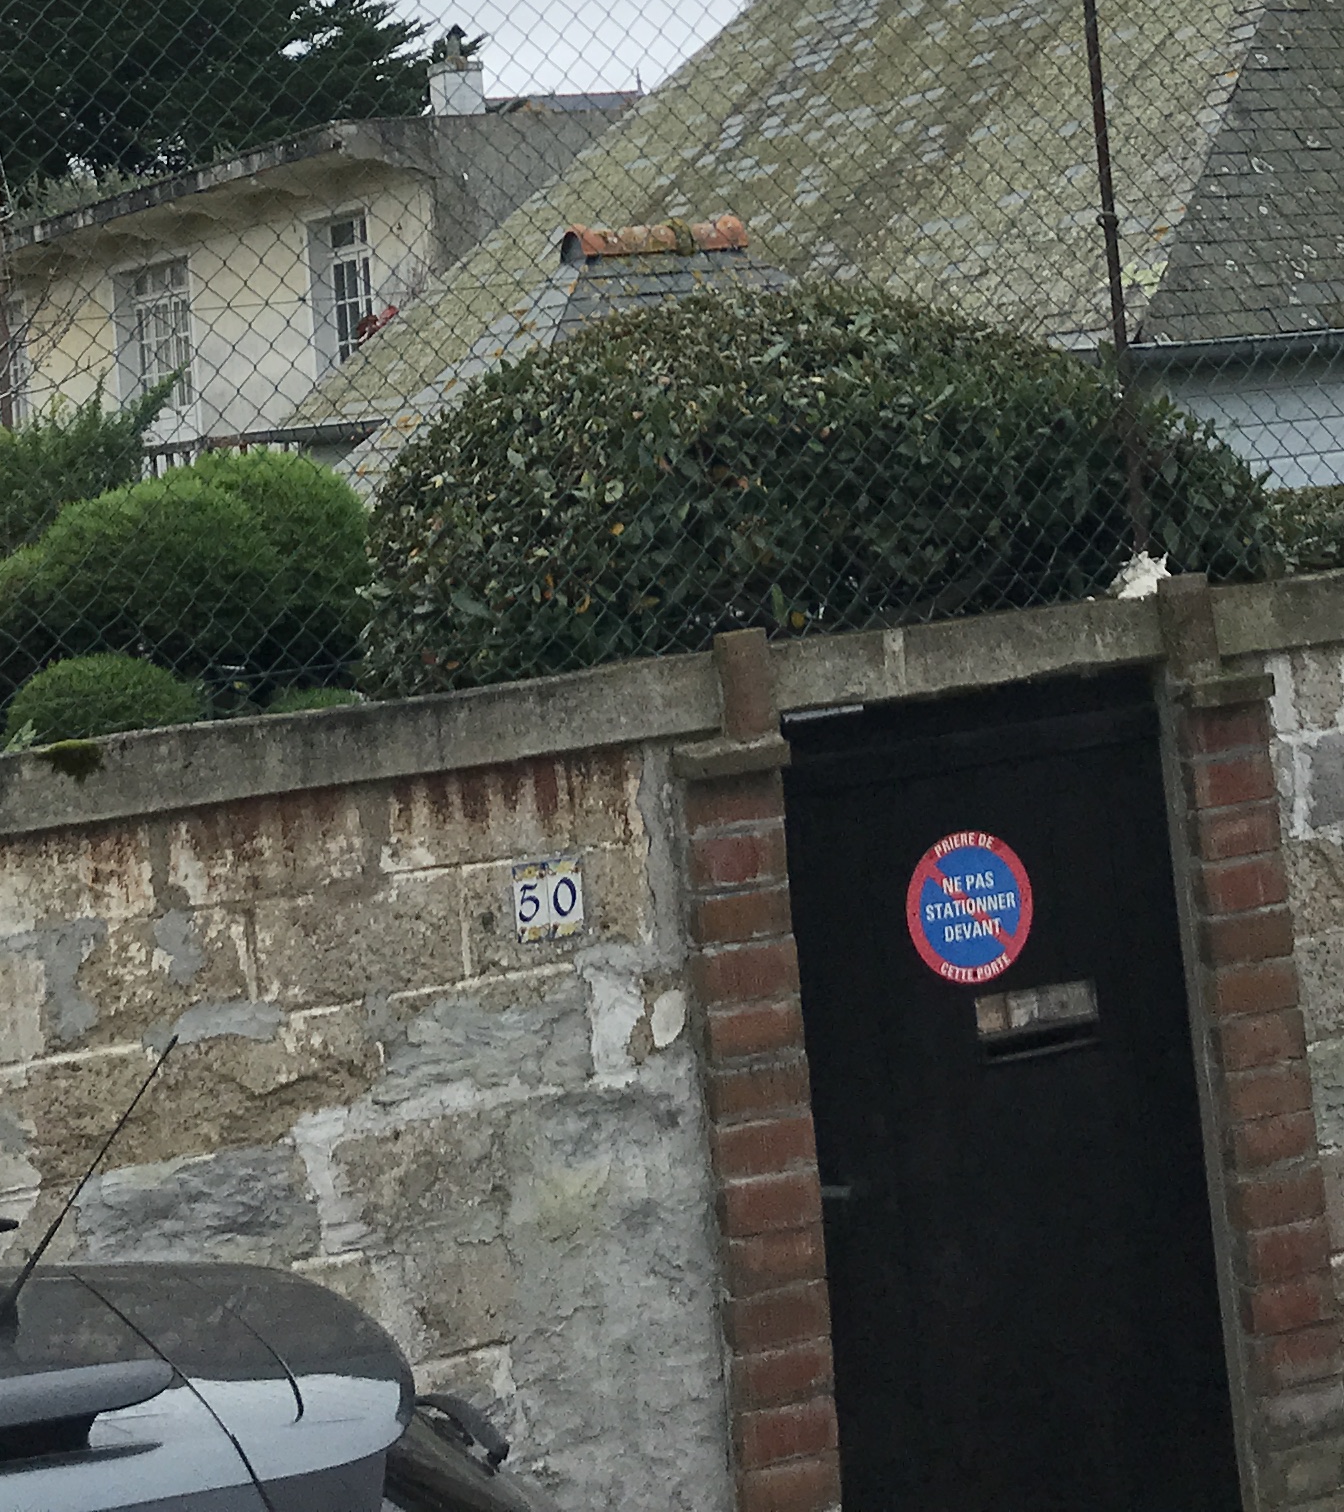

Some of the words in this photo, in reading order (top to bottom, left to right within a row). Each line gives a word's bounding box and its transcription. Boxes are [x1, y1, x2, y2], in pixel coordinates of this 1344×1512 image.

[978, 833, 995, 850] DE
[942, 876, 962, 895] NE
[965, 870, 995, 891] PAS
[518, 876, 577, 922] 50
[925, 891, 1016, 922] STATIONNER
[944, 917, 1002, 943] DEVANT
[940, 961, 974, 981] CETTE
[976, 952, 1012, 980] PORTE
